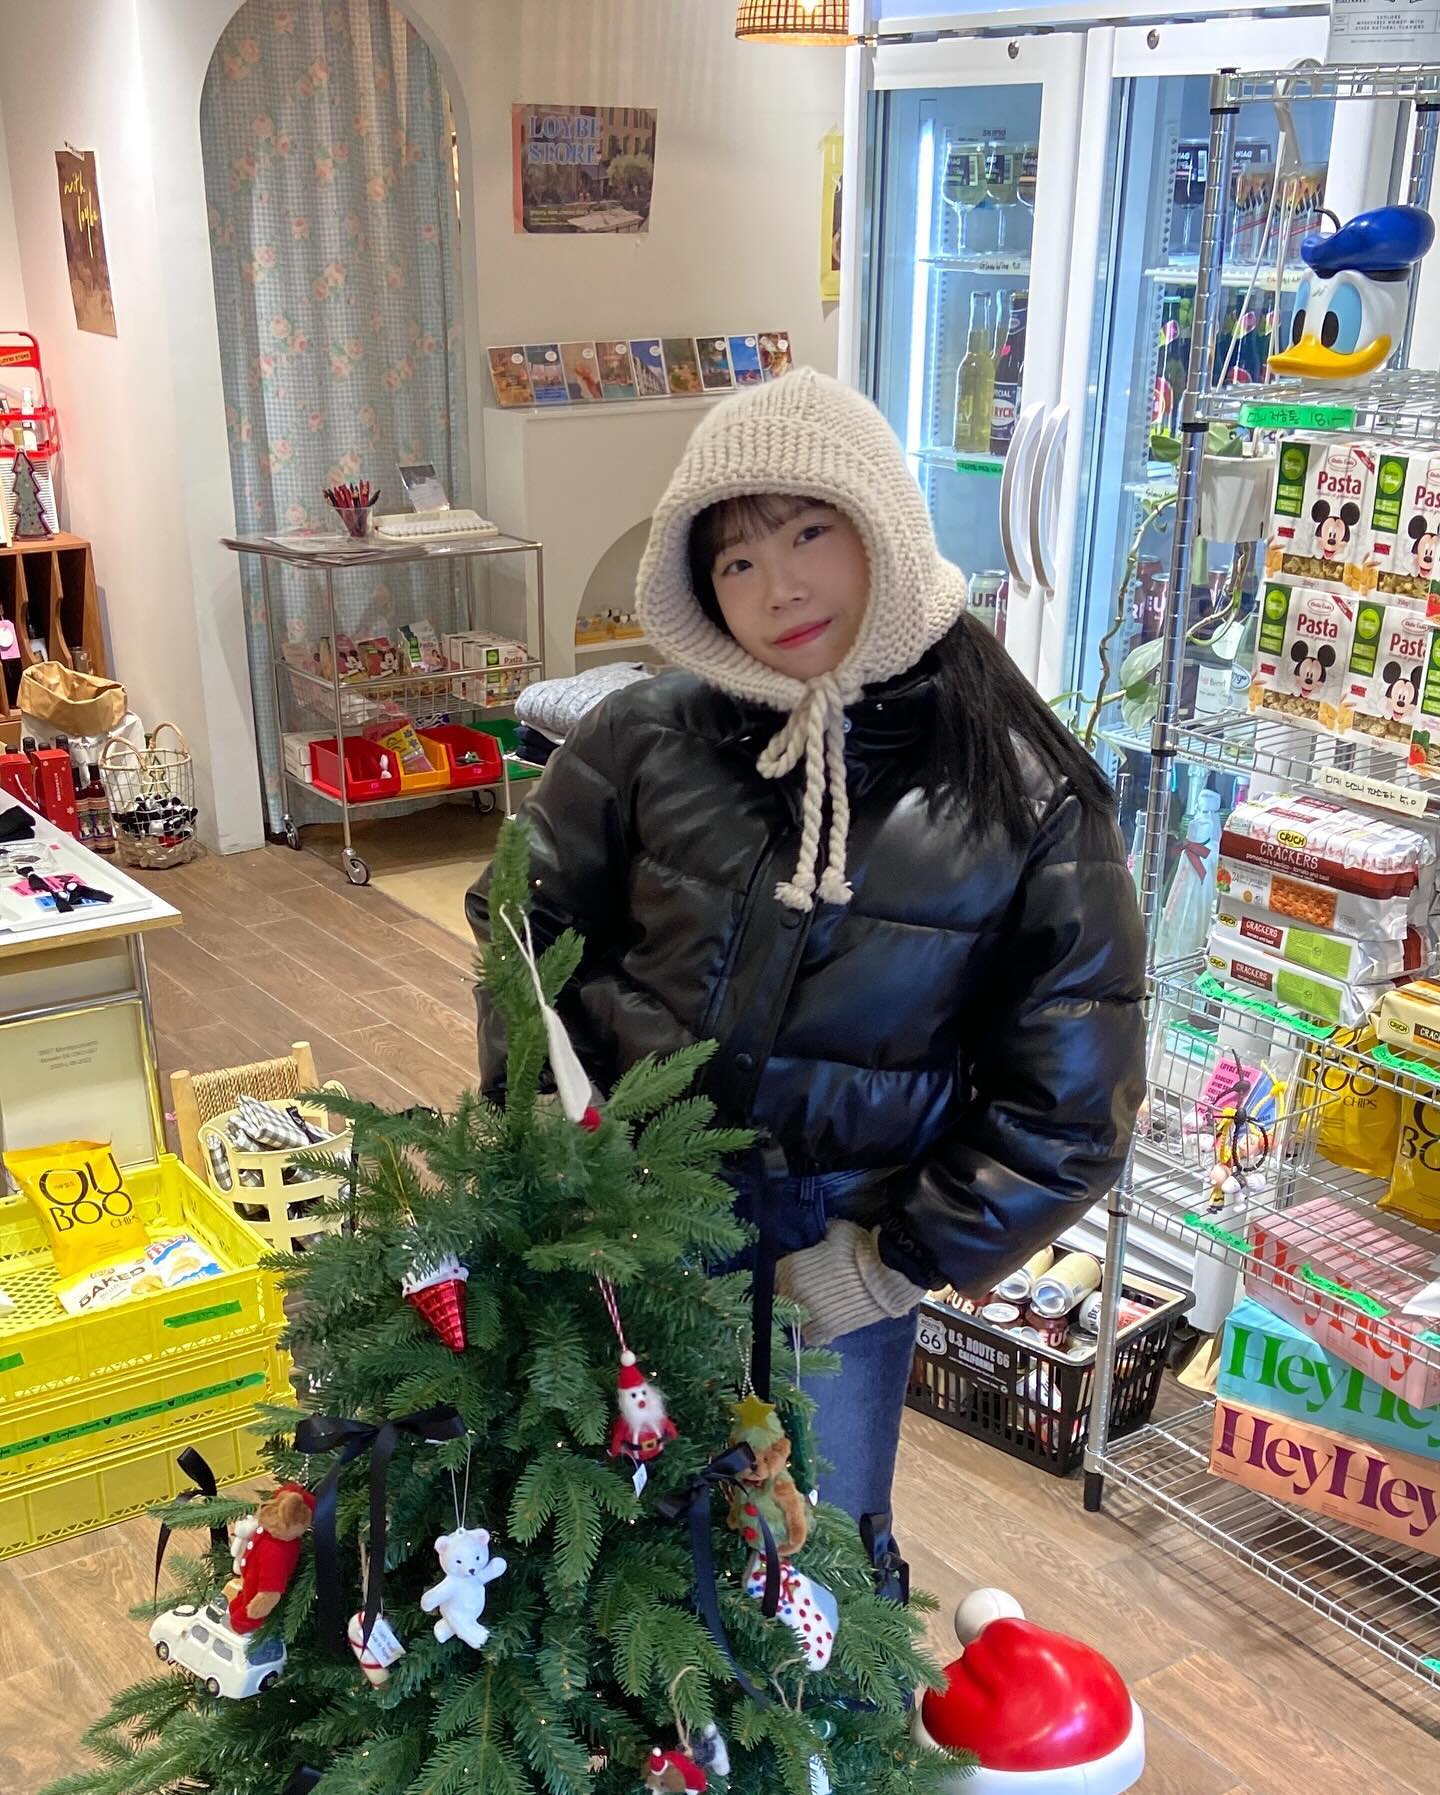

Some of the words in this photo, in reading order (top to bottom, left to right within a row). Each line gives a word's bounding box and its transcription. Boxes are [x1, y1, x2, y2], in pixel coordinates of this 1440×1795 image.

[64, 170, 86, 195] with
[1317, 471, 1362, 495] Pasta
[1296, 613, 1339, 639] Pasta
[1259, 842, 1319, 870] CRACKERS
[1245, 919, 1279, 939] CRACKERS
[1235, 962, 1269, 981] CRACKERS
[49, 1190, 133, 1232] BOO
[920, 1329, 941, 1349] 66
[965, 1337, 996, 1362] ROUTE
[996, 1351, 1010, 1368] 66
